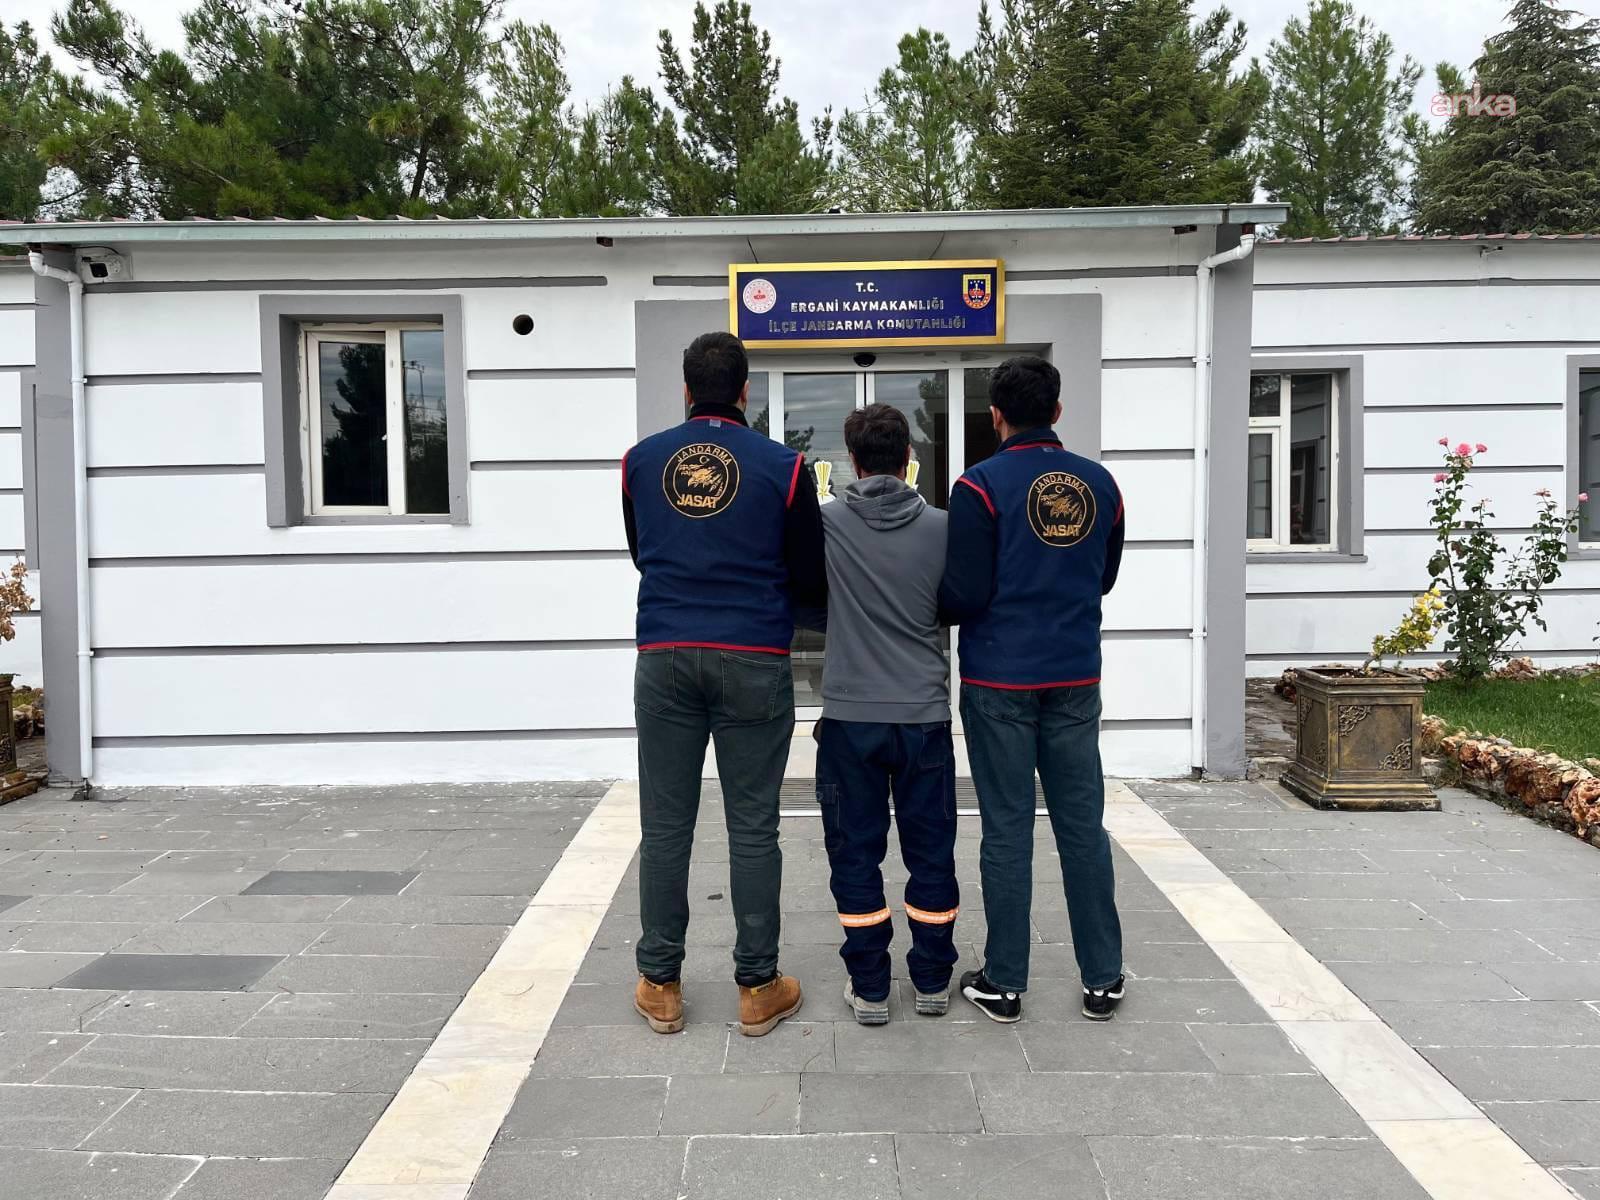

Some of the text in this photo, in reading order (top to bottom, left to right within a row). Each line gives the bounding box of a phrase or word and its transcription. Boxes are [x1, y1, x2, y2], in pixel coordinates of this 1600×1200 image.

[856, 282, 879, 293] T.C.
[790, 297, 944, 313] ERGANİ KAYMAKAMLIĞI
[769, 316, 966, 334] İLÇE JANDARMA KOMUTANLIĞI
[677, 445, 732, 467] JANDARMA
[1034, 474, 1086, 494] JANDARMA
[677, 494, 720, 508] JASAT
[1043, 524, 1081, 537] JASAT
